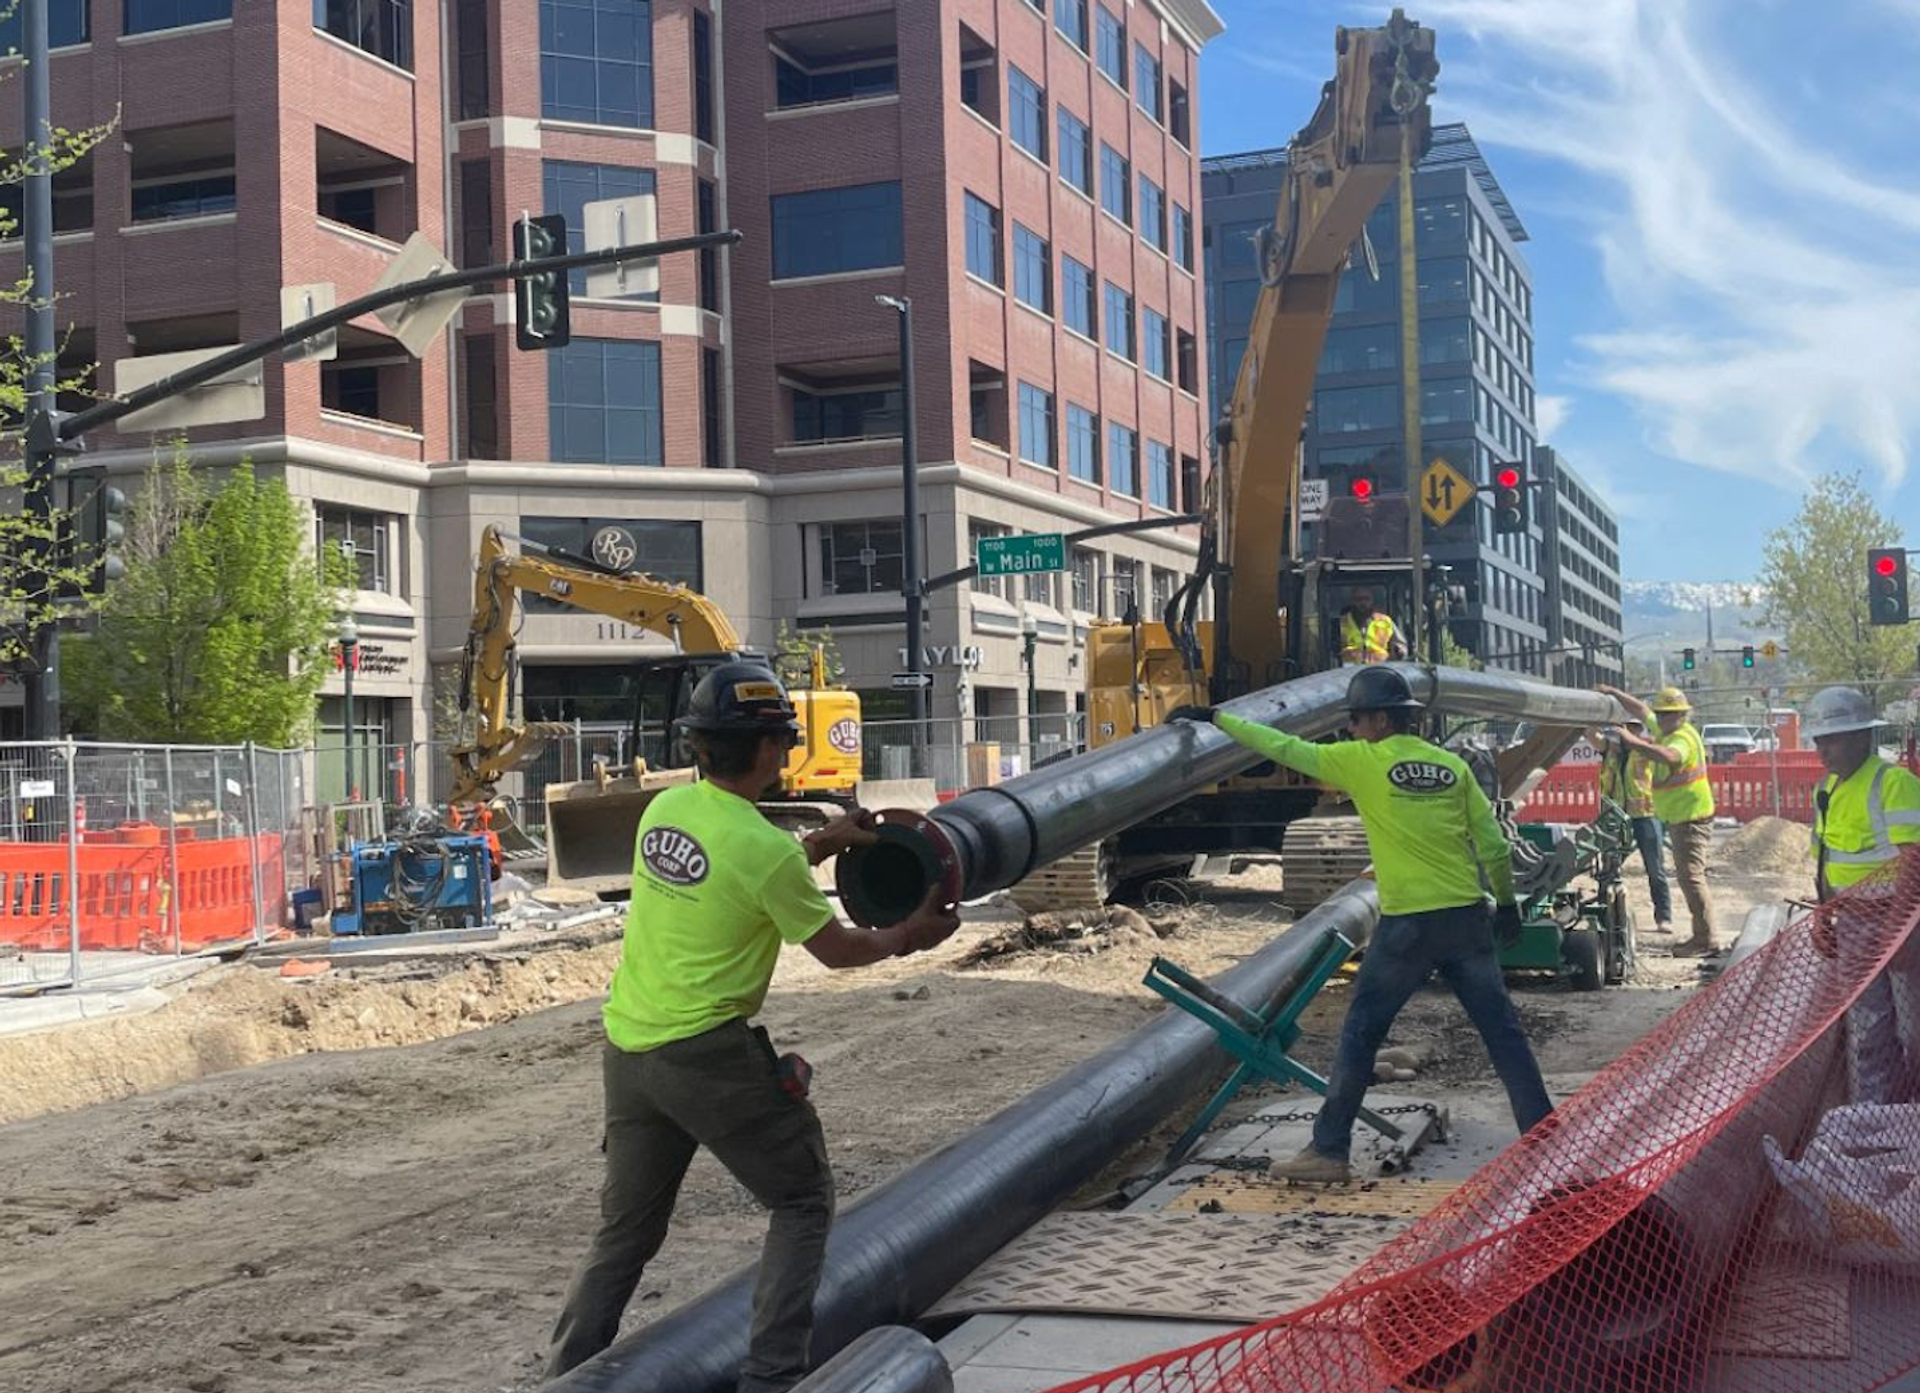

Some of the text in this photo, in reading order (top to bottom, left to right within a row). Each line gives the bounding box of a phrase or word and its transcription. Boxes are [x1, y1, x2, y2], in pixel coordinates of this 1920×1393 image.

[1301, 484, 1321, 493] ONE
[1301, 494, 1321, 505] WAY
[1033, 537, 1058, 547] 1000
[1000, 549, 1042, 572] Main
[597, 622, 646, 640] 1112
[1391, 763, 1455, 785] GUHO
[642, 830, 706, 879] GUHO
